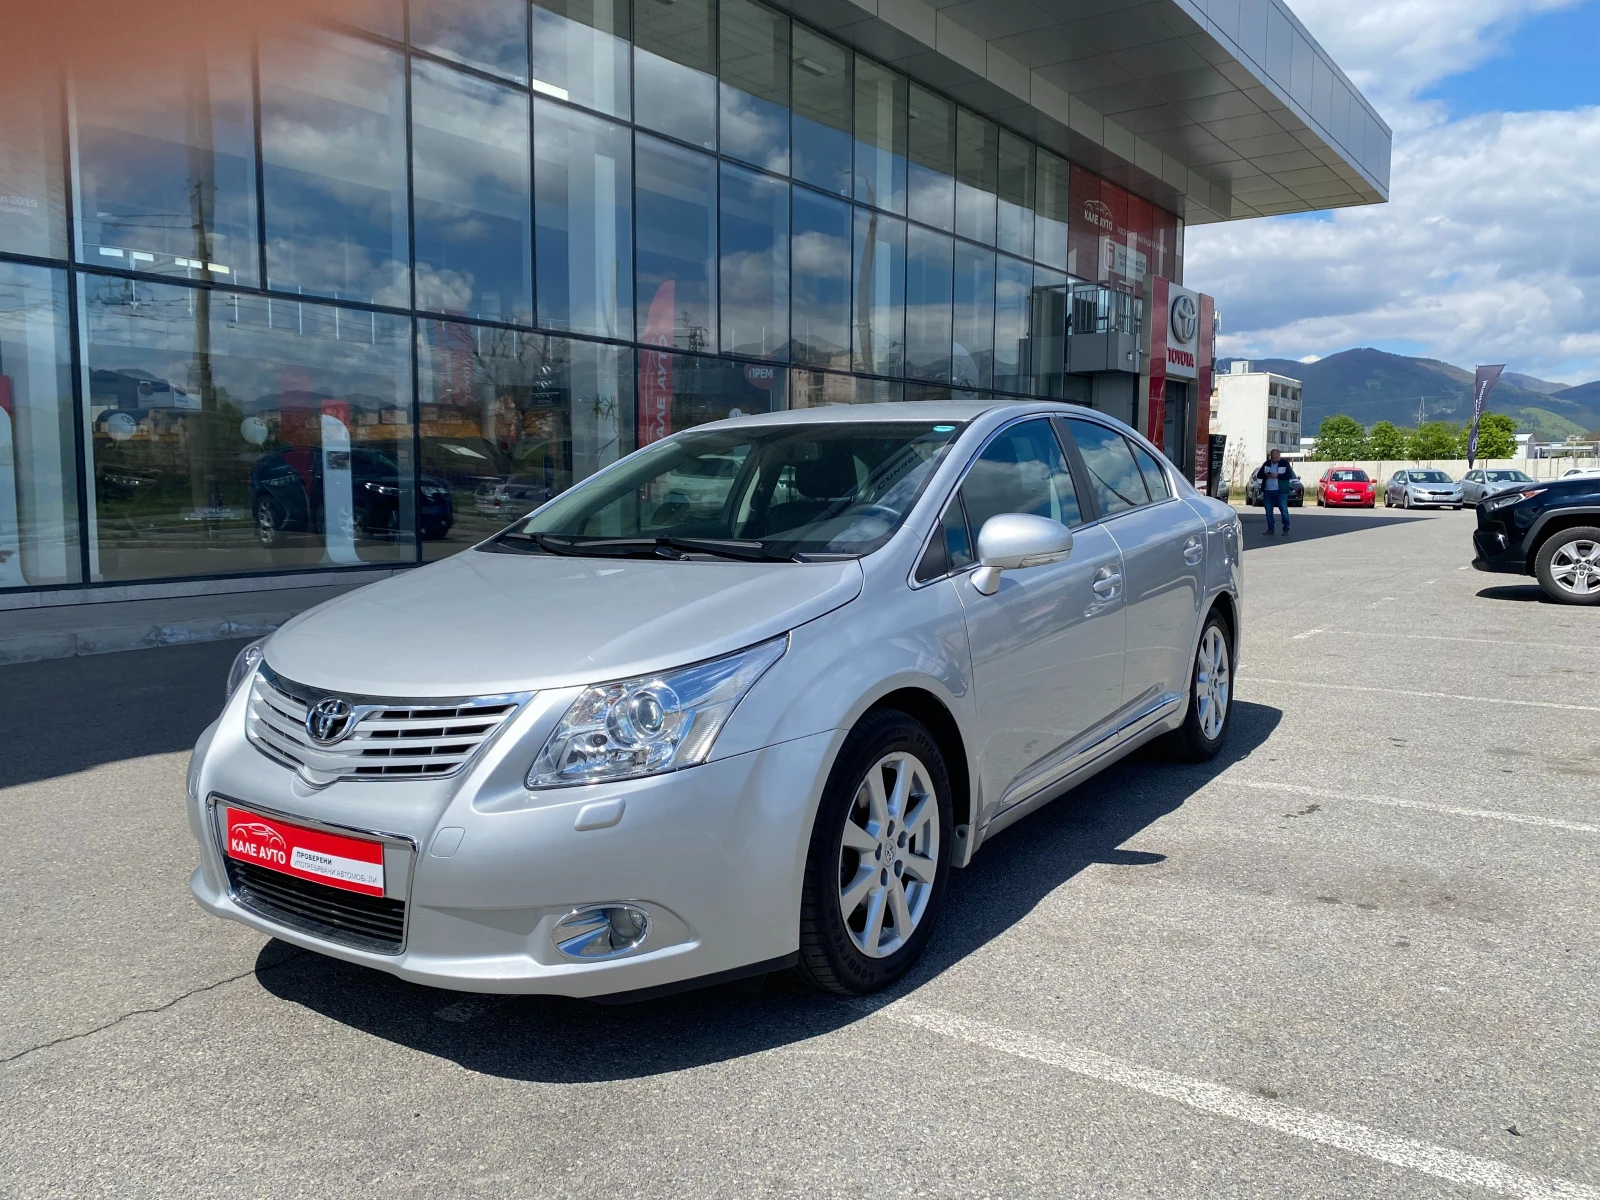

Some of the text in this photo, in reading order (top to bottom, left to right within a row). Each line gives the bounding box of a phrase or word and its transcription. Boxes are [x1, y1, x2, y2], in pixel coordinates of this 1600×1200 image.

[1084, 209, 1099, 226] КАЛЕ
[656, 334, 668, 391] АУТО
[1167, 347, 1195, 368] TOYOTA
[231, 838, 286, 865] КАЛЕ АУТО
[293, 859, 378, 884] УПОТРЕБЯВАНИ АВТОМОБЛИ
